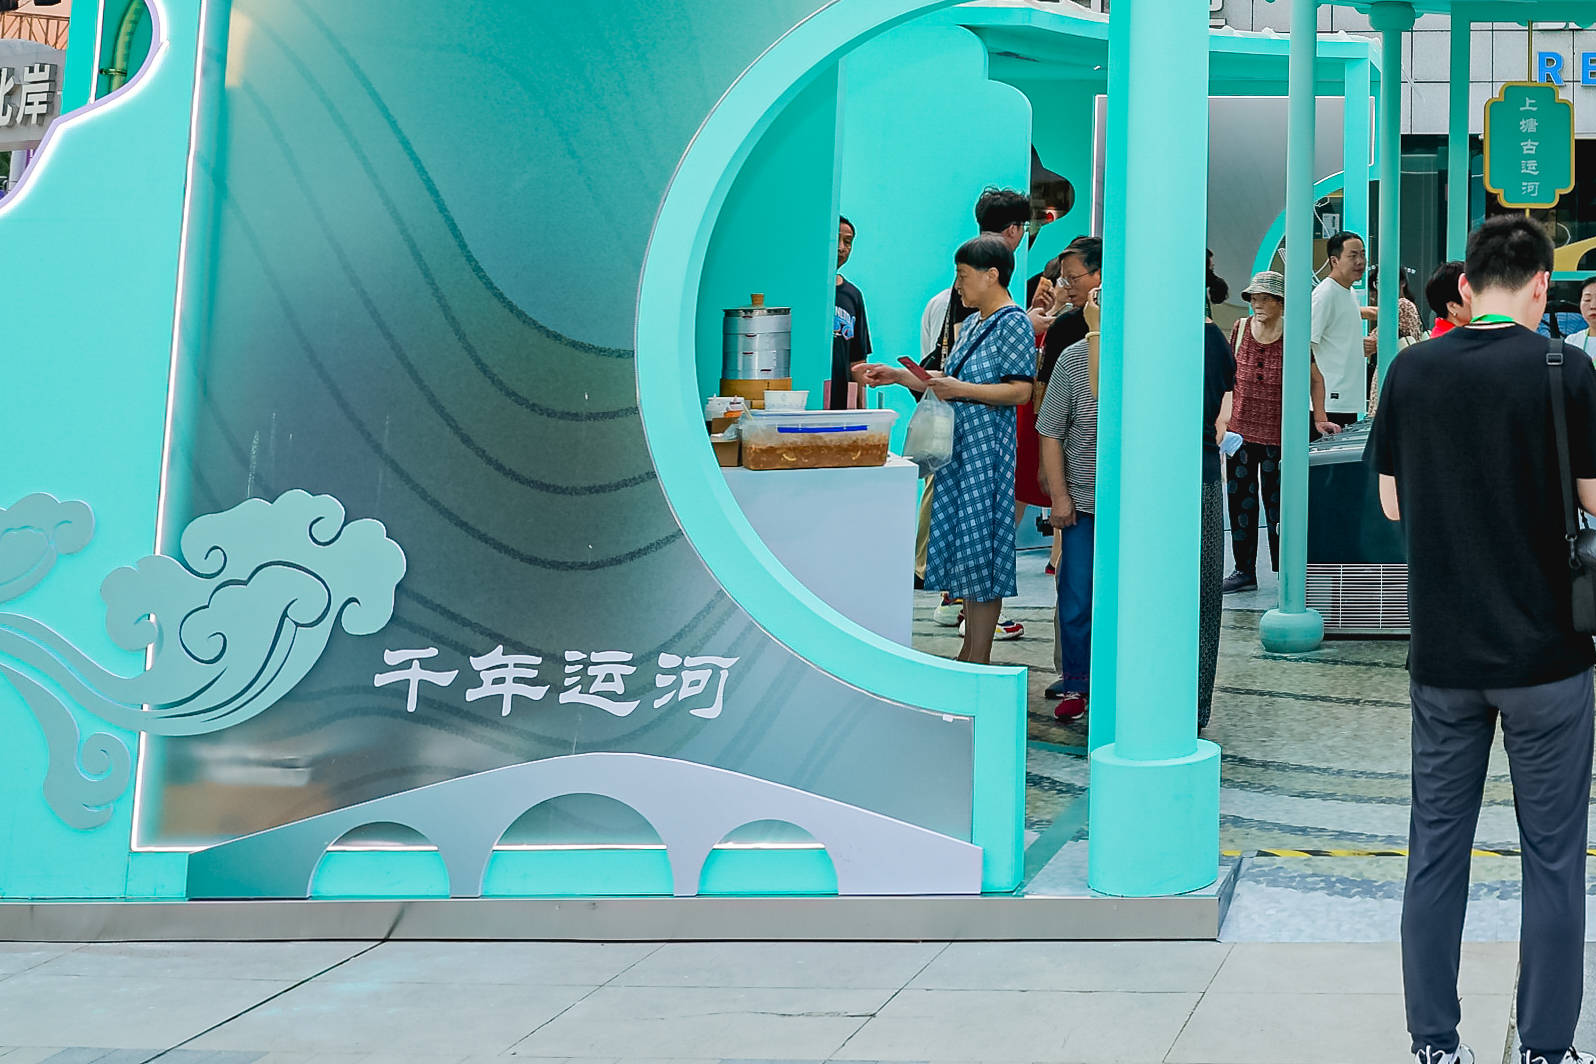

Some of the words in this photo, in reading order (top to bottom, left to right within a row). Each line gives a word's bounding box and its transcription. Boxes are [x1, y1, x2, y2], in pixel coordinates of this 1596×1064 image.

[1519, 96, 1541, 198] 上塘古运河
[373, 643, 741, 719] 千年运河
